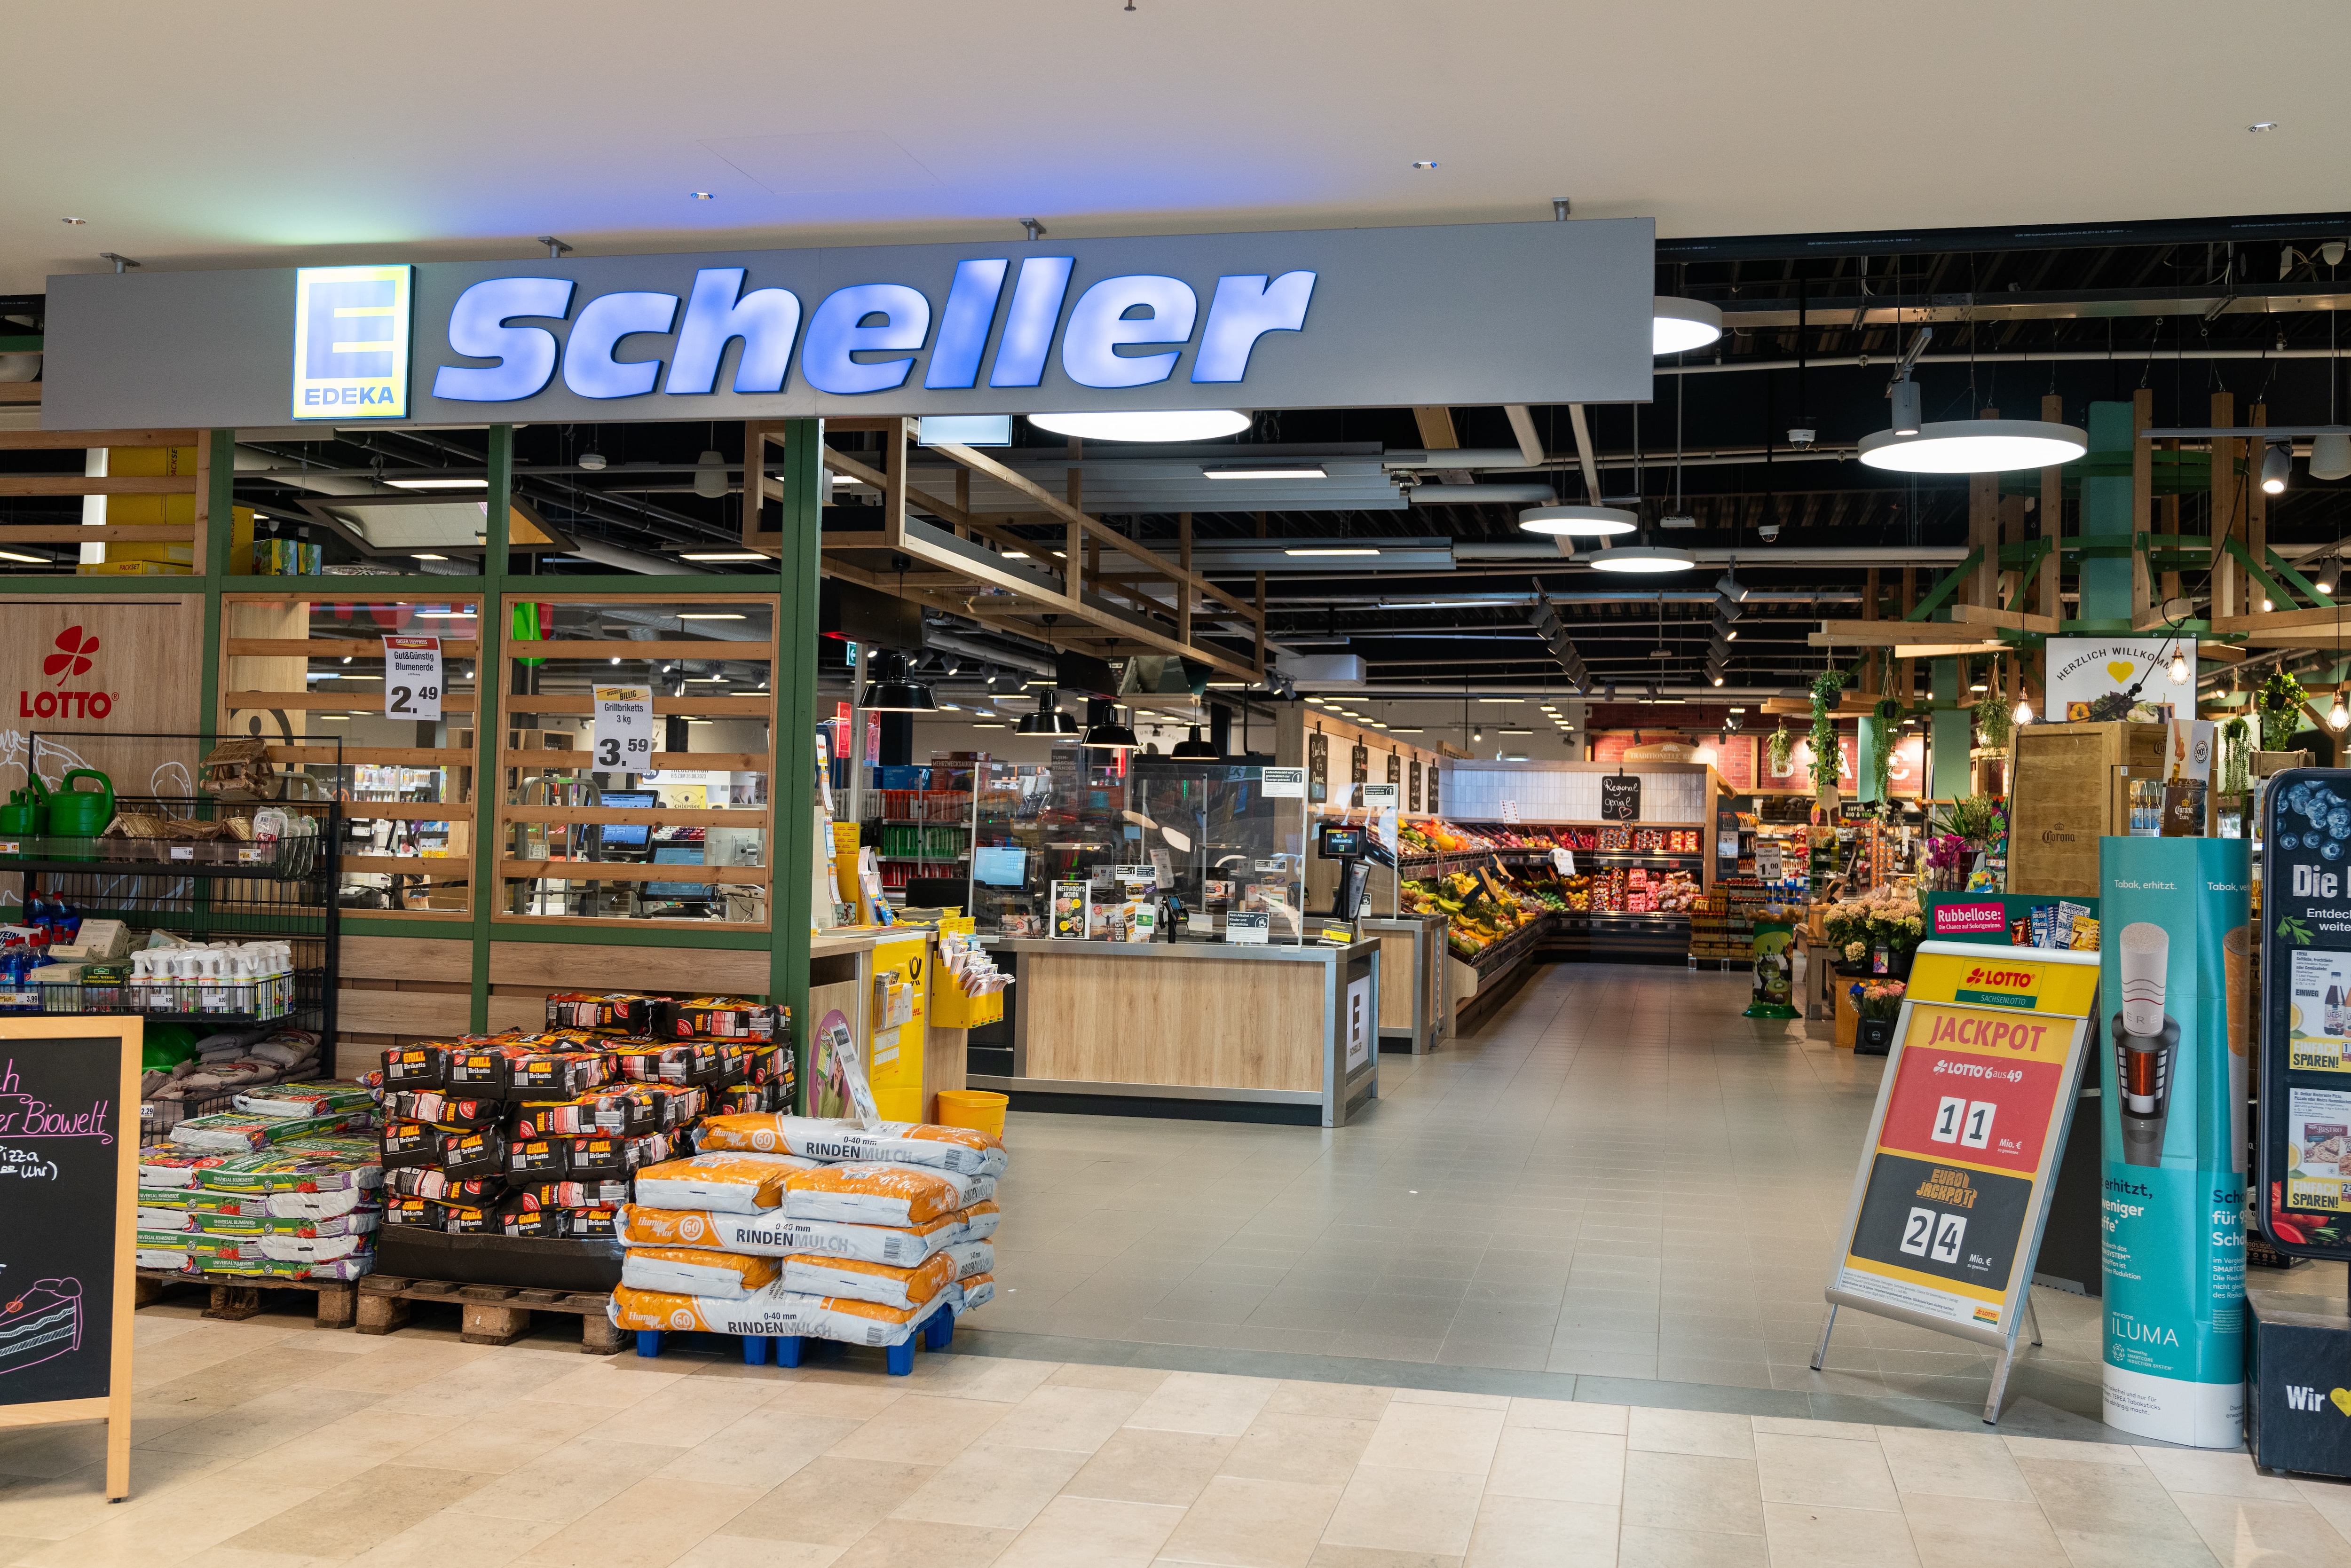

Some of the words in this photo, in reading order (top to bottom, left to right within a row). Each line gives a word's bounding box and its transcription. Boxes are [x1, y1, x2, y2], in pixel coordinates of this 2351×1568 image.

[432, 256, 1318, 402] Scheller
[305, 386, 394, 405] EDEKA
[394, 651, 434, 662] Gut&Günstig
[395, 662, 434, 671] Blumenerde
[2057, 648, 2106, 681] HERZLICH
[620, 690, 637, 701] BILLIG
[605, 703, 643, 712] Grillbriketts
[623, 715, 631, 725] kg
[1603, 778, 1639, 797] Regional
[1603, 796, 1633, 813] genial
[2175, 805, 2193, 815] Corona
[2042, 828, 2075, 845] Corona
[2114, 880, 2141, 890] Tabak,
[2143, 880, 2177, 890] erhitzt.
[2293, 864, 2338, 898] Die
[1938, 908, 2001, 922] Rubbellose:
[1980, 994, 2026, 1005] SACHSENLOTTO
[1928, 1015, 2048, 1052] JACKPOT
[1350, 1041, 1362, 1057] SCHELLER
[2294, 1041, 2339, 1056] EINFACH
[403, 1050, 426, 1064] GRILL
[468, 1056, 491, 1068] GRILL
[2293, 1053, 2339, 1069] SPAREN!
[529, 1062, 552, 1073] GRILL
[22, 1100, 108, 1135] Biowelt
[712, 1128, 736, 1140] Humo
[756, 1134, 771, 1145] 60
[844, 1135, 861, 1144] 0-40
[589, 1140, 611, 1152] GRILL
[1999, 1138, 2015, 1149] Mio.
[2015, 1141, 2022, 1150] €
[806, 1142, 912, 1163] RINDENMULCH
[1930, 1168, 1964, 1188] EURO
[1916, 1182, 1973, 1206] JACKPOT
[2105, 1177, 2153, 1199] erhitzt,
[2293, 1181, 2339, 1197] EINFACH
[2293, 1193, 2339, 1208] SPAREN!
[638, 1216, 662, 1227] Humo
[2212, 1210, 2237, 1225] für
[683, 1221, 700, 1234] 60
[736, 1228, 848, 1252] RINDENMULCH
[2117, 1243, 2127, 1252] das
[1969, 1253, 1985, 1265] Mio.
[1986, 1257, 1992, 1266] €
[628, 1311, 654, 1321] Humo
[673, 1314, 690, 1326] 60
[764, 1312, 781, 1320] 0-40
[727, 1321, 832, 1337] RINDENMULCH
[2112, 1317, 2179, 1347] ILUMA
[2127, 1353, 2153, 1363] SMARTCORE
[2112, 1393, 2126, 1402] TEREA
[2127, 1398, 2161, 1410] Tabaksticks
[2147, 1394, 2157, 1403] für
[2286, 1385, 2326, 1412] Wir
